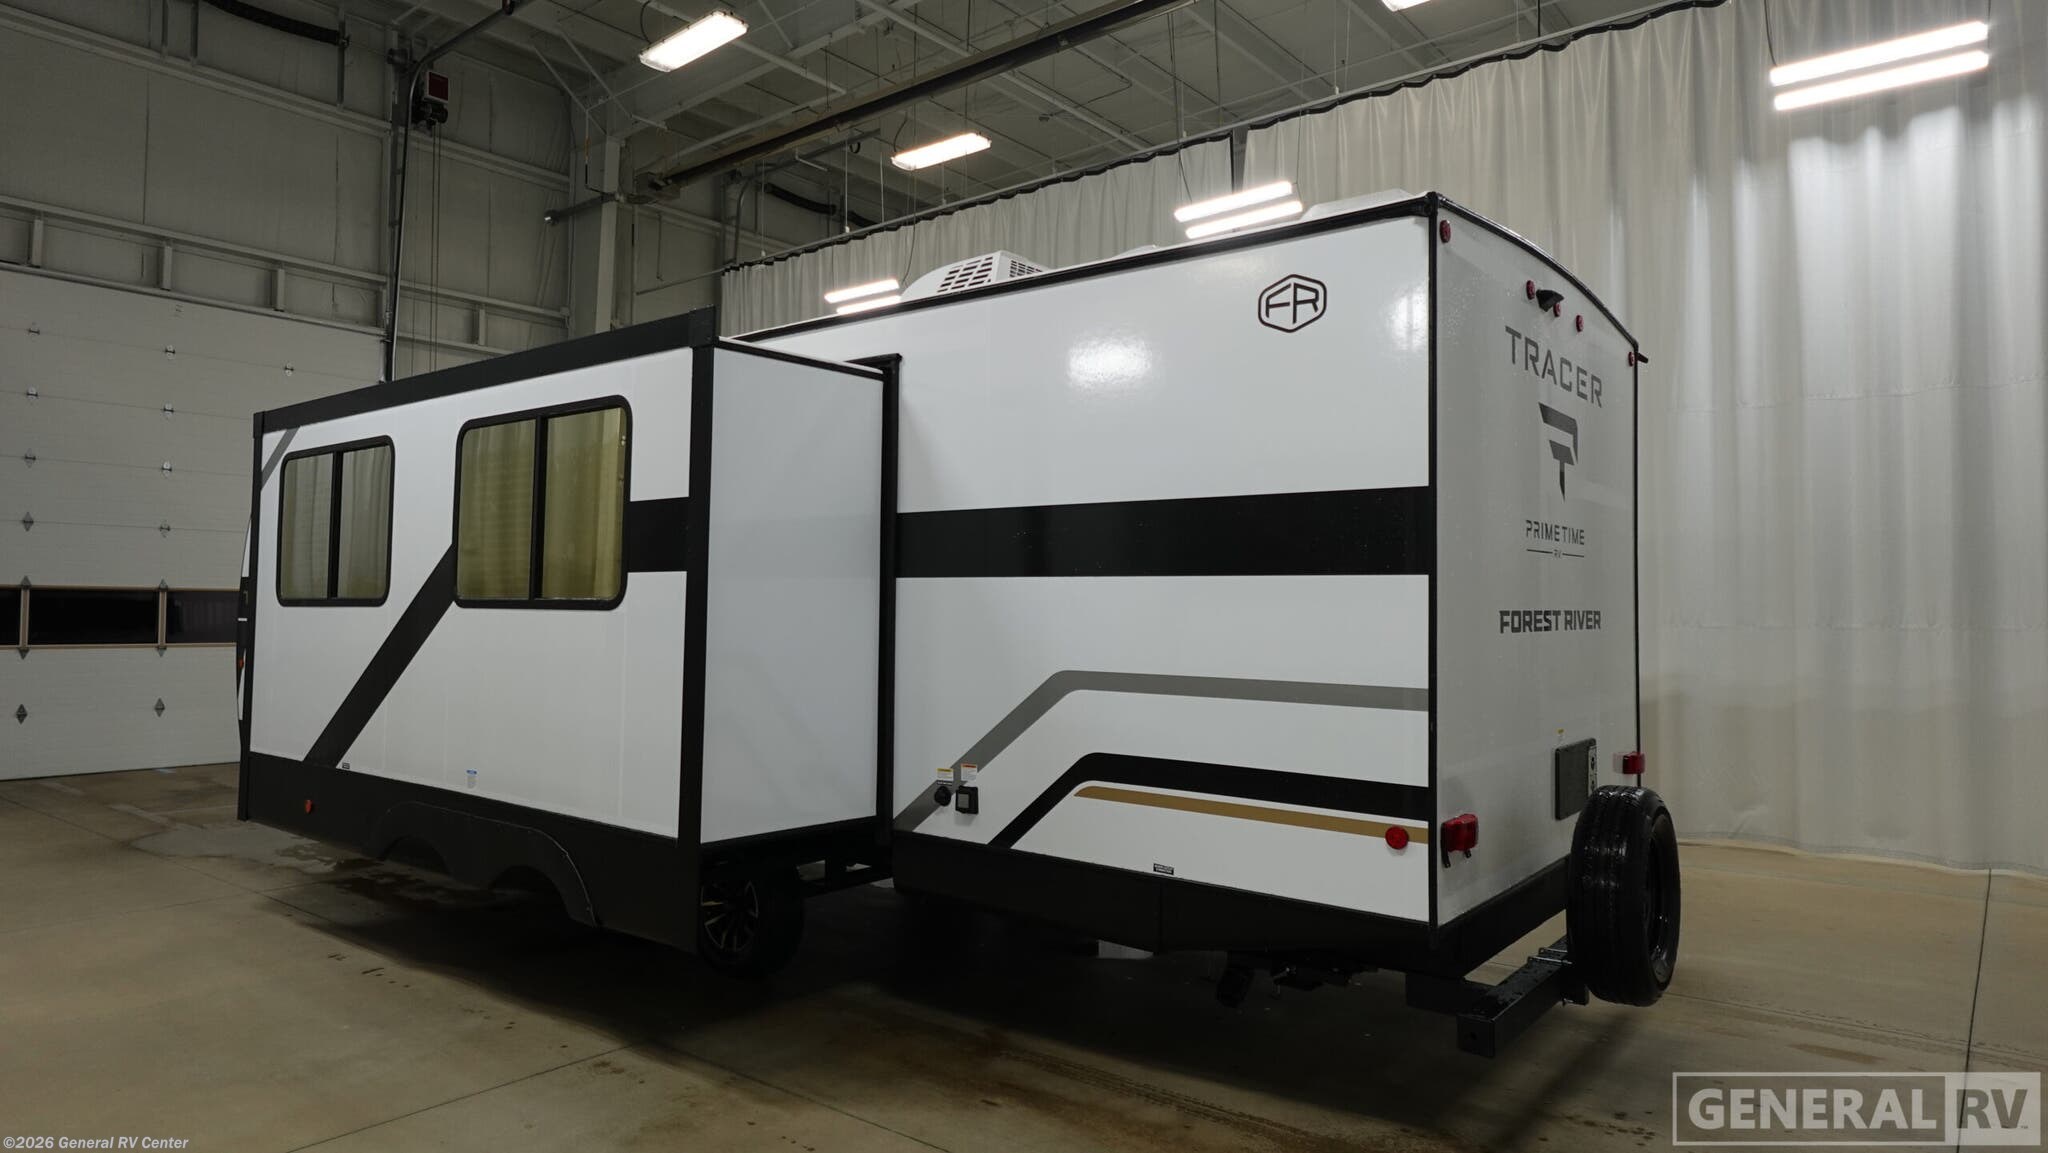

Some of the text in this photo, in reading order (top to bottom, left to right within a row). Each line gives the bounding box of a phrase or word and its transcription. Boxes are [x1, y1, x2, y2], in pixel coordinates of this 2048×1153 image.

[1505, 325, 1602, 408] TRACER
[1499, 610, 1601, 634] FOREST RIVER
